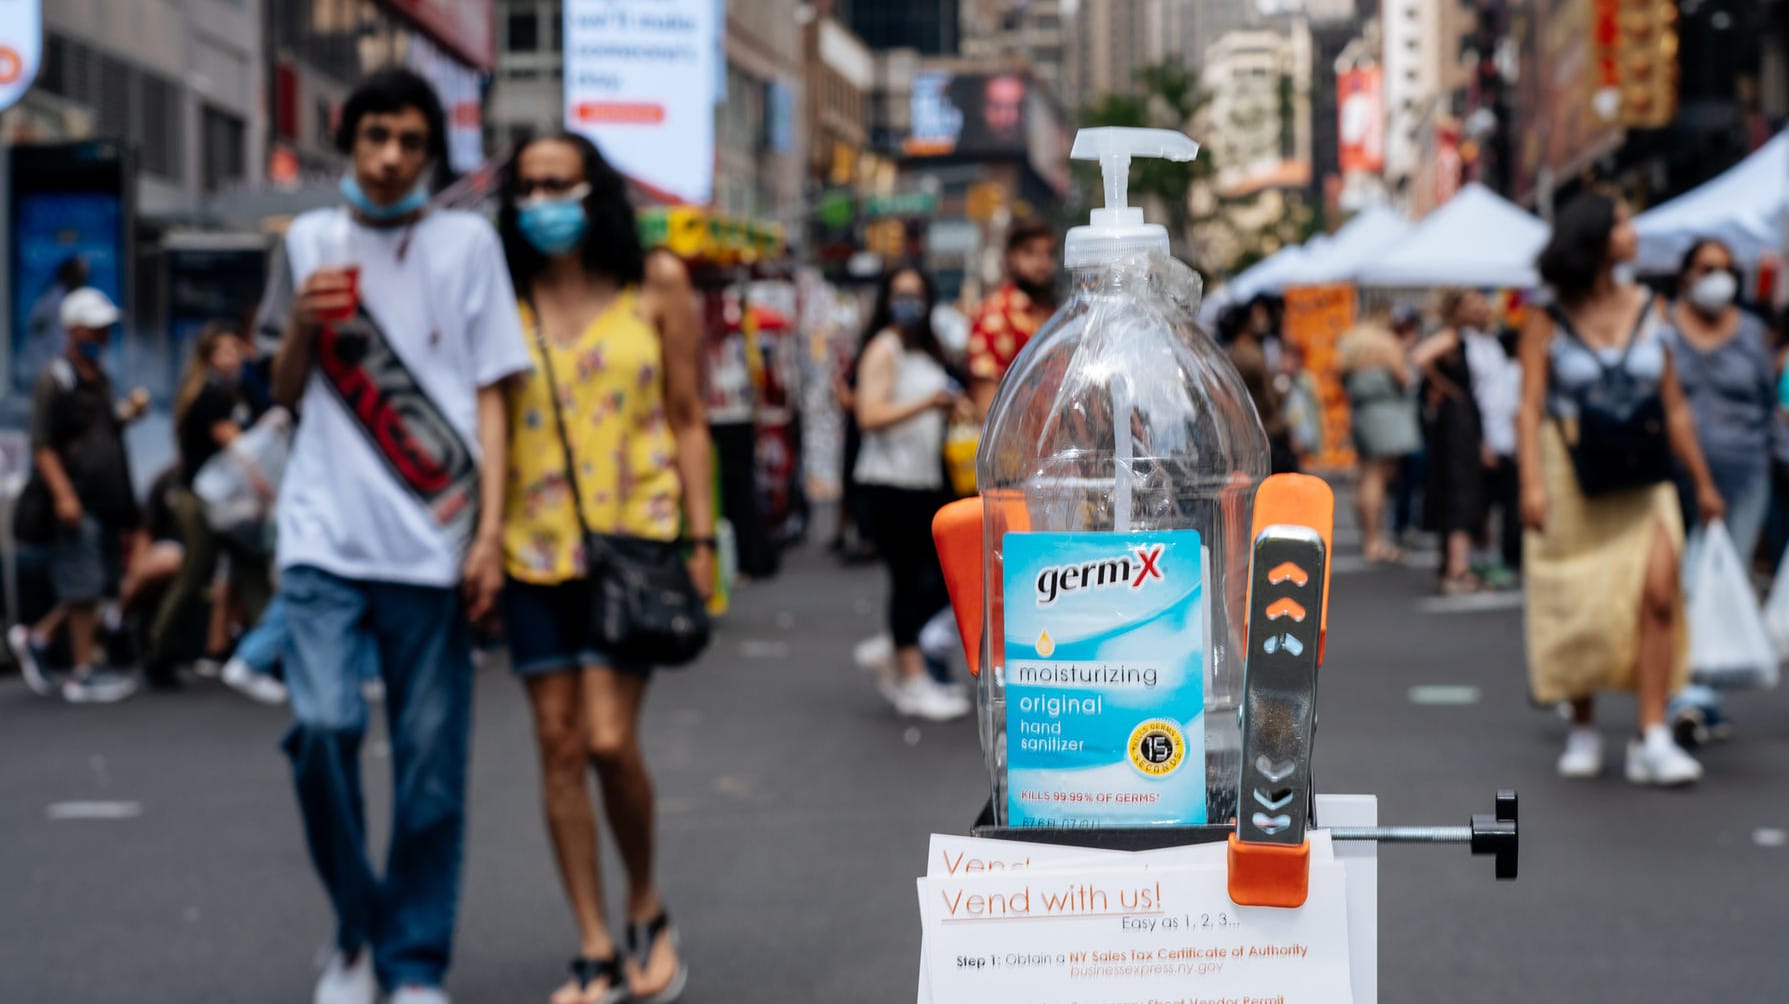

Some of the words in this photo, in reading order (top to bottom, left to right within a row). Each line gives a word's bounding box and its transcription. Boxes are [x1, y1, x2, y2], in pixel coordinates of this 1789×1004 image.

[1037, 547, 1162, 603] germ-X
[1019, 664, 1158, 687] moisturizing
[1020, 693, 1102, 717] original
[1021, 719, 1061, 735] hand
[1021, 736, 1084, 752] sanitizer
[1146, 736, 1168, 762] 15
[1021, 790, 1050, 801] KILLS
[1053, 791, 1093, 802] 99.99%
[1096, 792, 1113, 803] OF
[942, 886, 1030, 915] Vend
[1040, 882, 1109, 913] with
[1120, 881, 1162, 910] us!
[1122, 916, 1156, 933] Easy
[1162, 917, 1179, 929] as
[1185, 914, 1196, 929] 1,
[1201, 913, 1214, 929] 2,
[1219, 912, 1241, 927] 3...
[956, 955, 986, 969] Step
[991, 955, 1001, 967] 1:
[1006, 952, 1052, 967] Obtain
[1056, 954, 1065, 964] a
[1070, 952, 1087, 963] NY
[1092, 950, 1127, 962] Sales
[1131, 949, 1153, 962] Tax
[1157, 946, 1227, 960] Certificate
[1232, 945, 1245, 957] of
[1249, 944, 1309, 959] Authority
[1070, 962, 1224, 978] businessexpress.ny.gov
